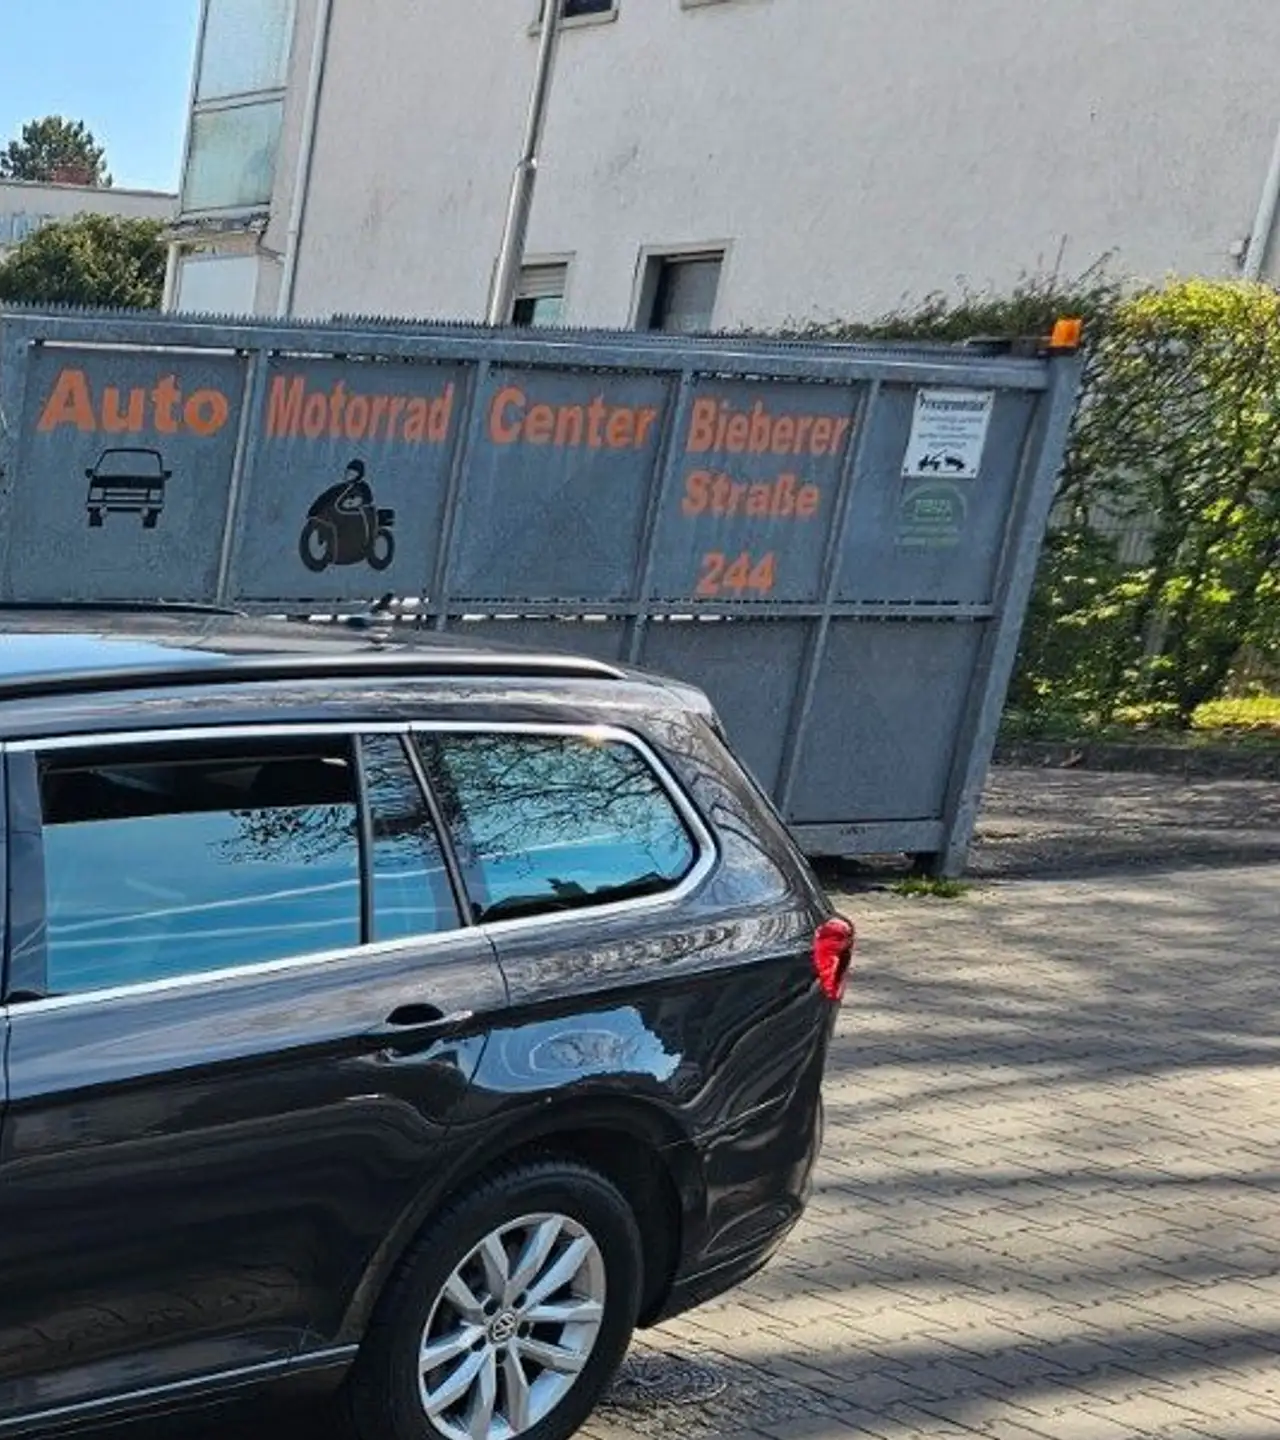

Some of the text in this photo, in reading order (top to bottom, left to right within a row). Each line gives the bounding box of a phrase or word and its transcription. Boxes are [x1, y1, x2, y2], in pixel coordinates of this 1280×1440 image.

[40, 369, 848, 455] Auto Motorrad Center Bieberer
[683, 472, 819, 516] Straße
[697, 553, 775, 595] 244
